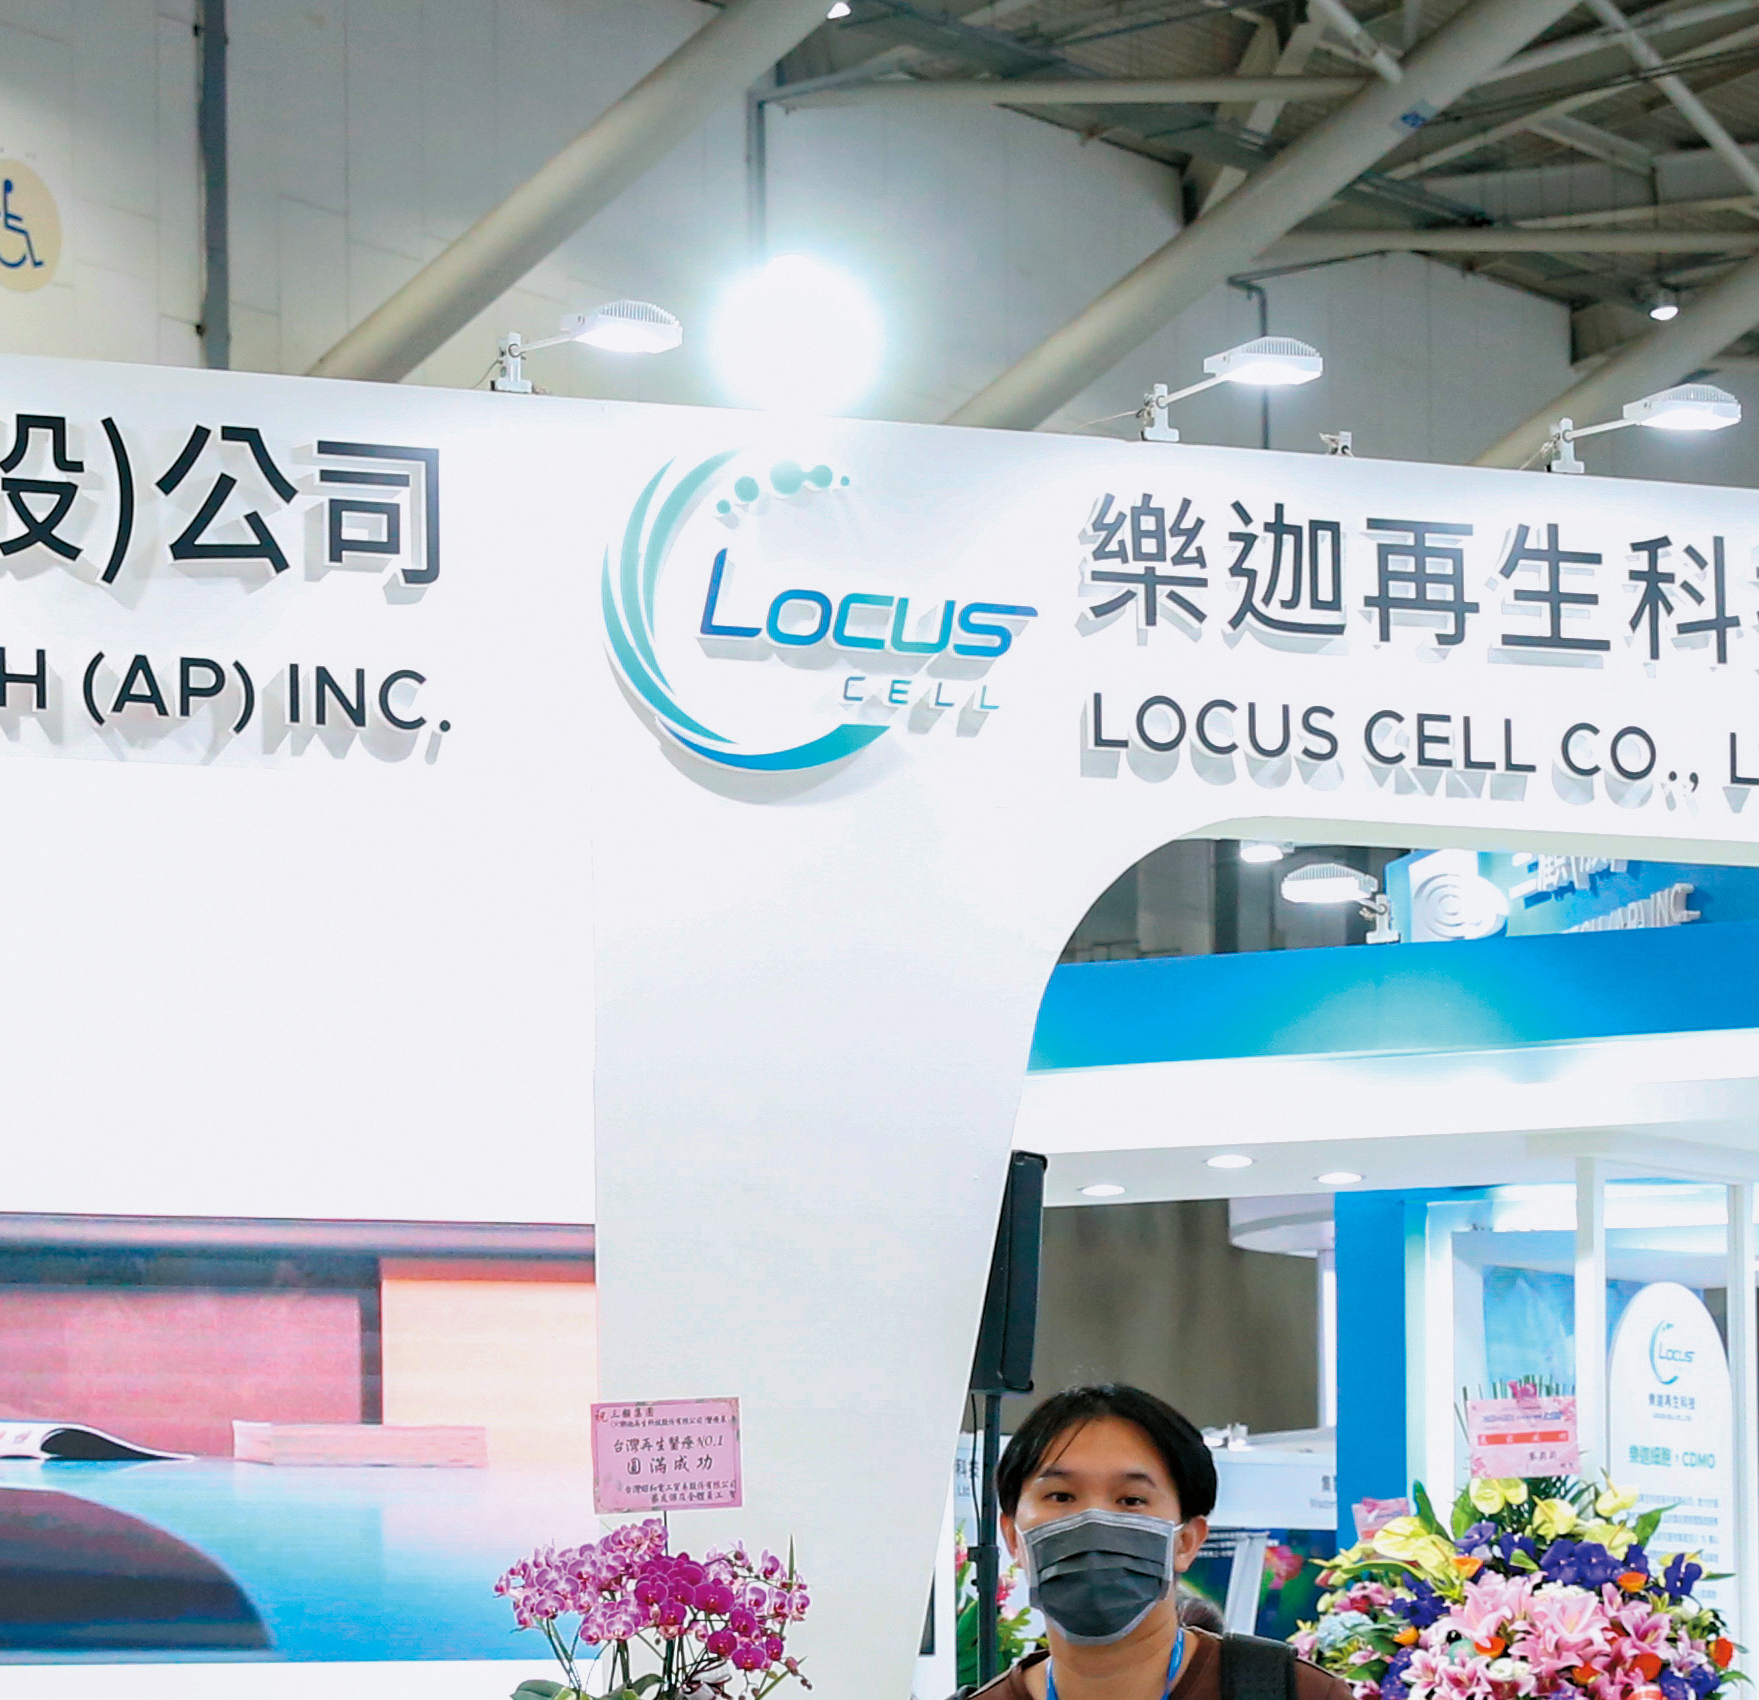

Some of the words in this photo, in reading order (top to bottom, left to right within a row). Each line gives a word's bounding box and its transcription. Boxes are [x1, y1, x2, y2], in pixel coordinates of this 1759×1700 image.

[82, 652, 256, 735] (AP)
[288, 662, 452, 734] INC.
[842, 676, 1000, 711] CELL
[1092, 692, 1340, 762] LOCUS
[1363, 709, 1537, 774] CELL
[1560, 722, 1700, 793] CO.,
[627, 1454, 713, 1475] 圓滿成功
